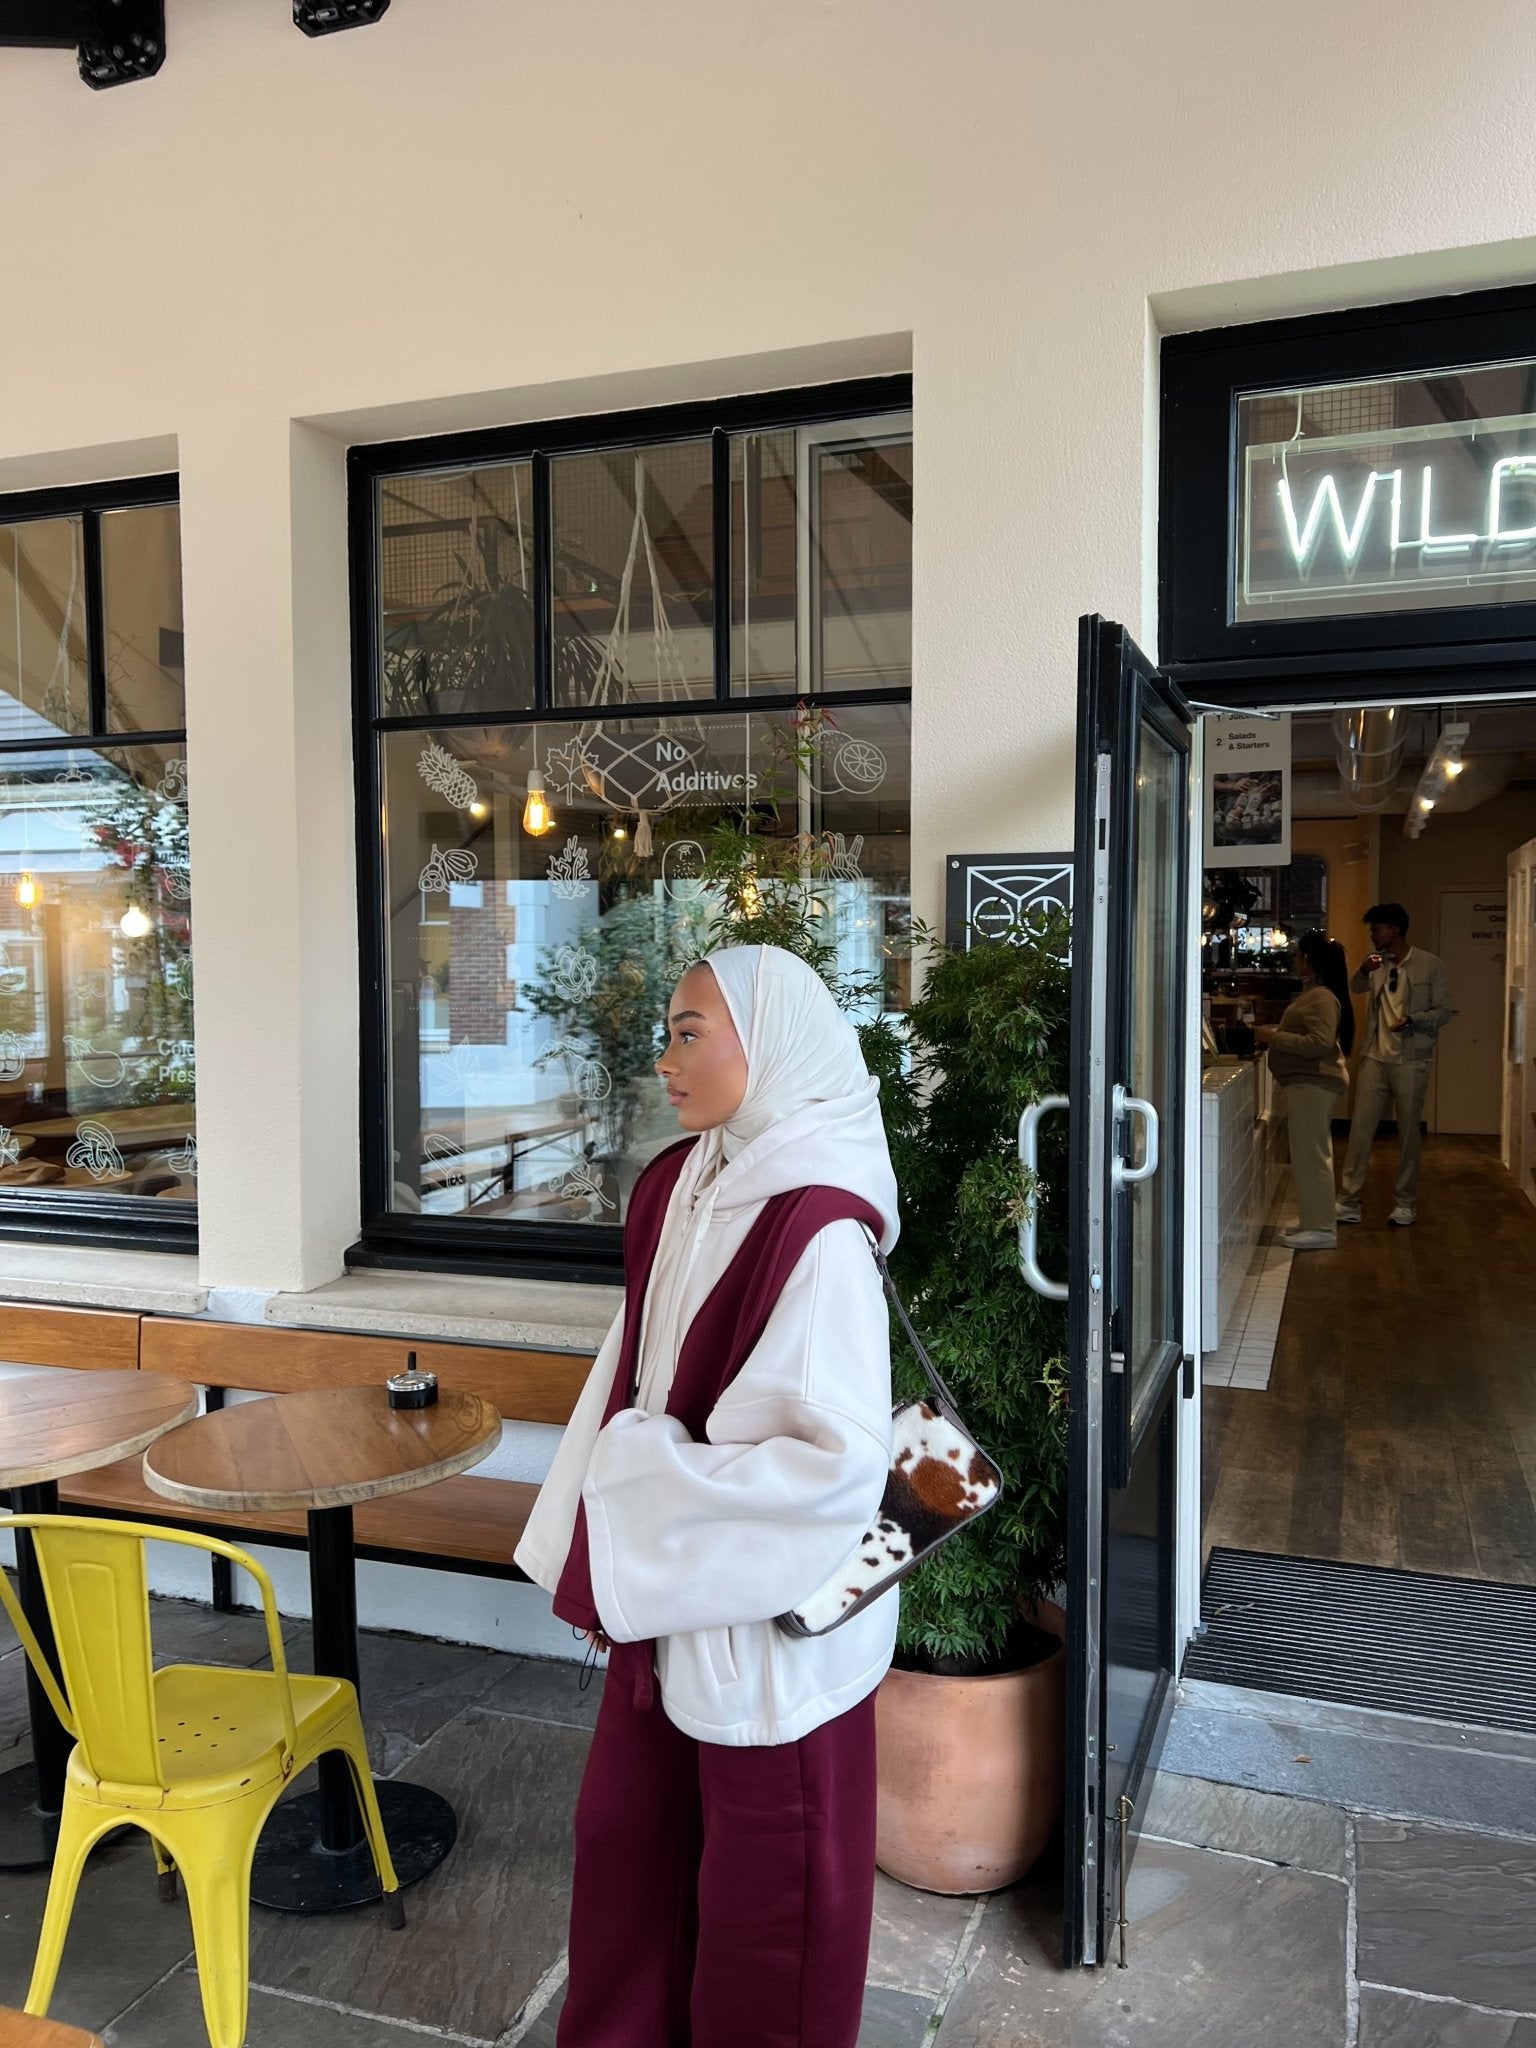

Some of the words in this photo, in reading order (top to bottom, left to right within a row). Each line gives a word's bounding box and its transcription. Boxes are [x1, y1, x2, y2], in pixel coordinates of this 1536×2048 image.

[1278, 456, 1536, 562] WILD
[1216, 738, 1223, 746] 2
[1228, 732, 1257, 740] Salads
[656, 741, 686, 762] No
[1228, 743, 1235, 751] &
[1236, 742, 1270, 750] Starters
[655, 770, 759, 792] Additives
